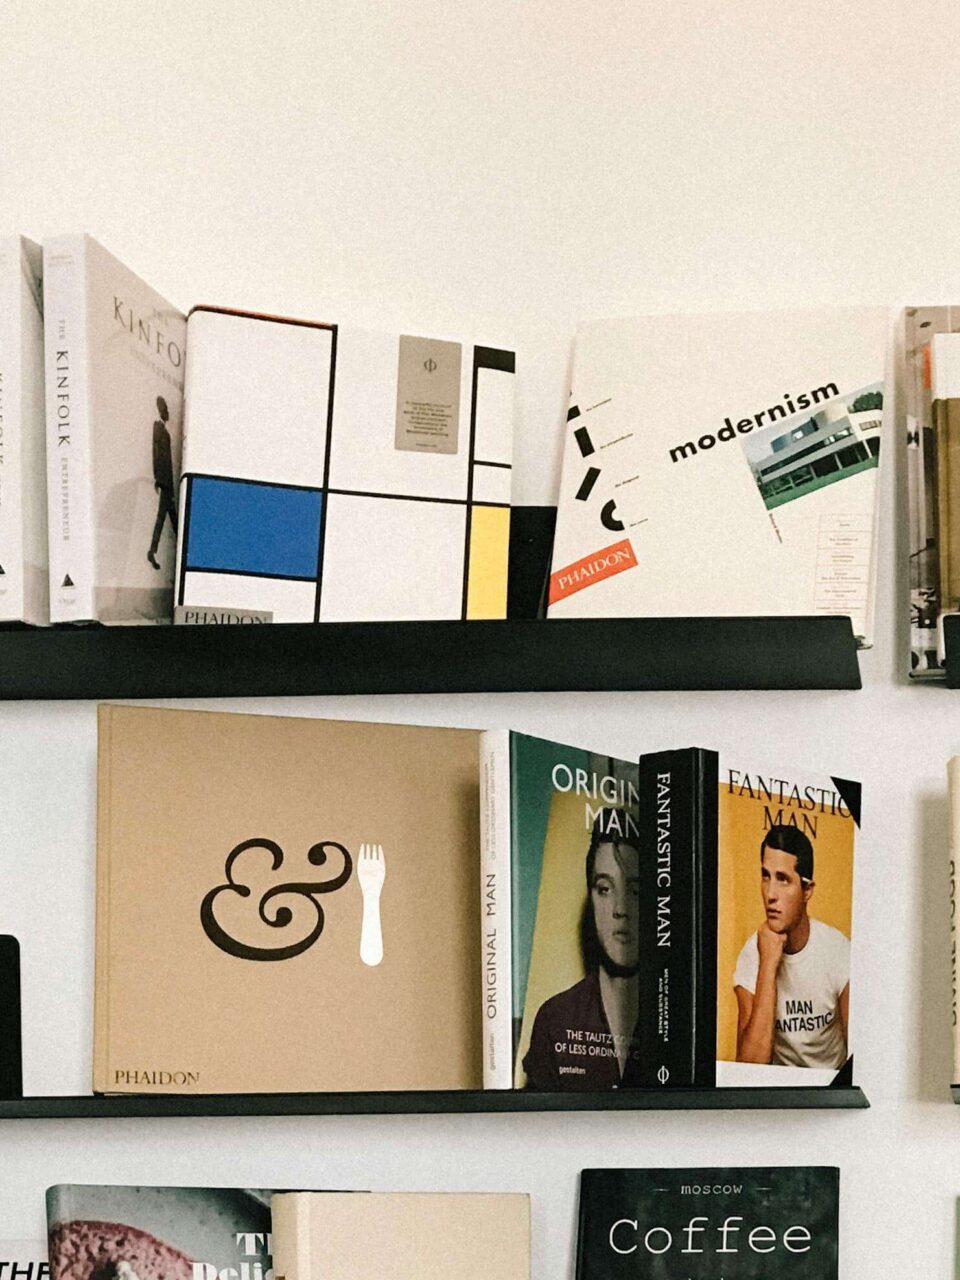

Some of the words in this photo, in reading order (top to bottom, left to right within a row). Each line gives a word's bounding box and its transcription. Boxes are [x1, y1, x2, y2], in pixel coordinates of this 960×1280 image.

[112, 296, 183, 368] KINFO
[55, 350, 71, 447] KINFOLK
[668, 382, 840, 463] modernism
[558, 547, 632, 590] PHAIDON
[727, 769, 853, 819] FANTASTIC
[656, 771, 672, 888] FANTASTIC
[762, 805, 818, 839] MAN
[486, 873, 497, 916] MAN
[656, 897, 672, 948] MAN
[486, 928, 498, 1020] ORIGINAL
[774, 1012, 835, 1033] ANTASTIC
[785, 1000, 814, 1017] MAN
[555, 1042, 567, 1053] OF
[569, 1044, 586, 1056] LESS
[566, 1029, 583, 1041] THE
[585, 1031, 612, 1044] TAUTZ
[114, 1069, 200, 1086] PHAIDON
[680, 1183, 744, 1196] moscow
[608, 1216, 813, 1255] Coffee
